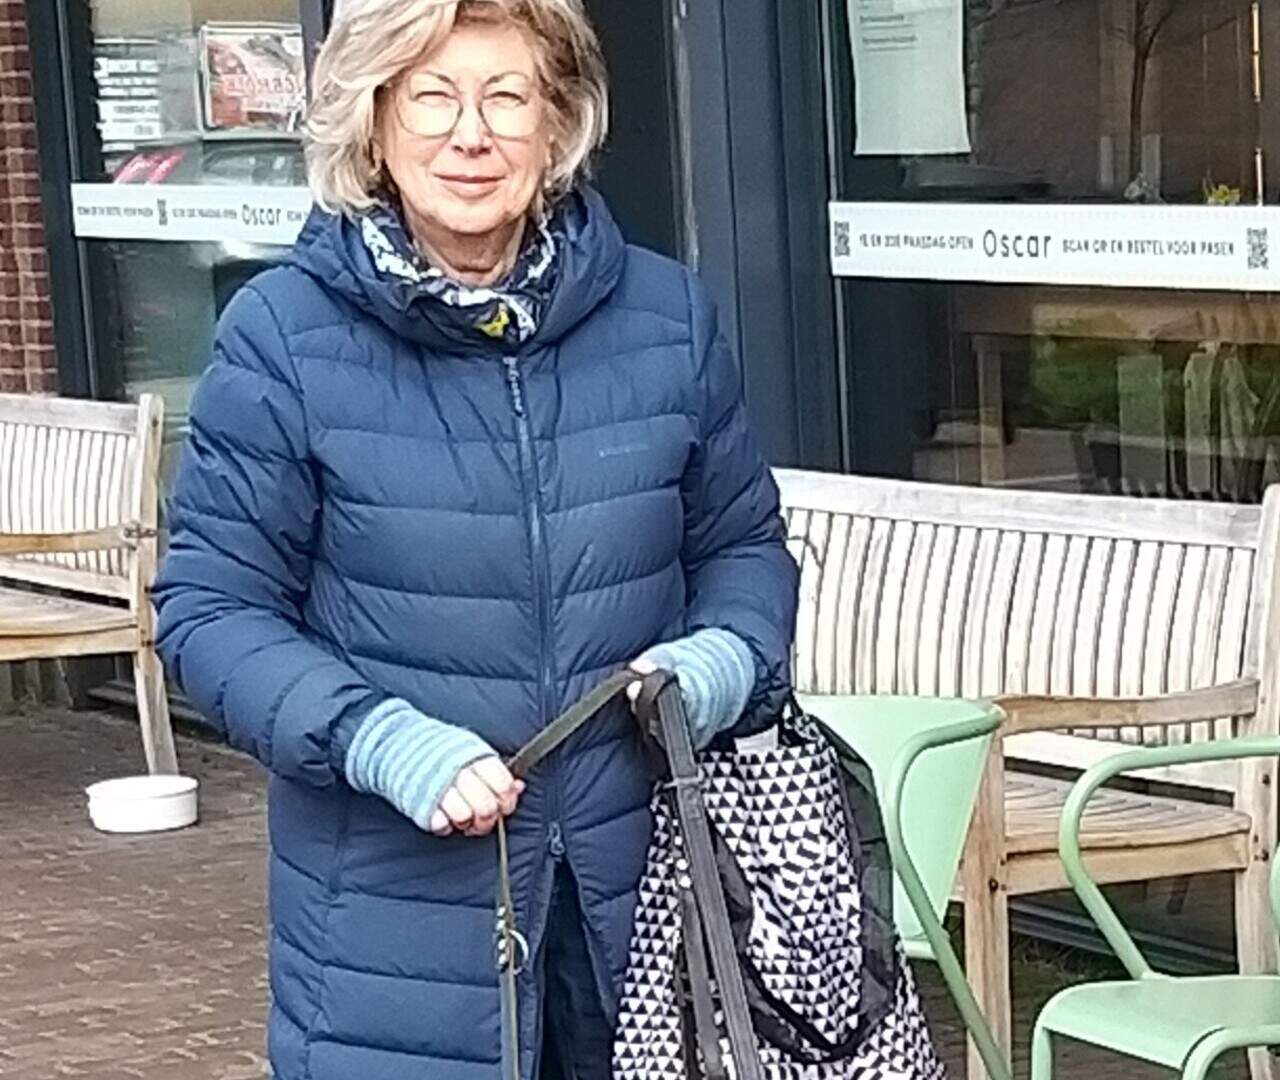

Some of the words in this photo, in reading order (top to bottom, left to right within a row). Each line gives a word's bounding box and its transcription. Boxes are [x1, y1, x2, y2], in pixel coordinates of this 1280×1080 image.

[241, 203, 282, 227] Oscar
[983, 229, 1052, 259] Oscar
[1062, 239, 1090, 254] SCAN
[1127, 239, 1165, 256] BESTEL
[1166, 240, 1197, 256] VOOR
[1200, 241, 1234, 257] PASEN
